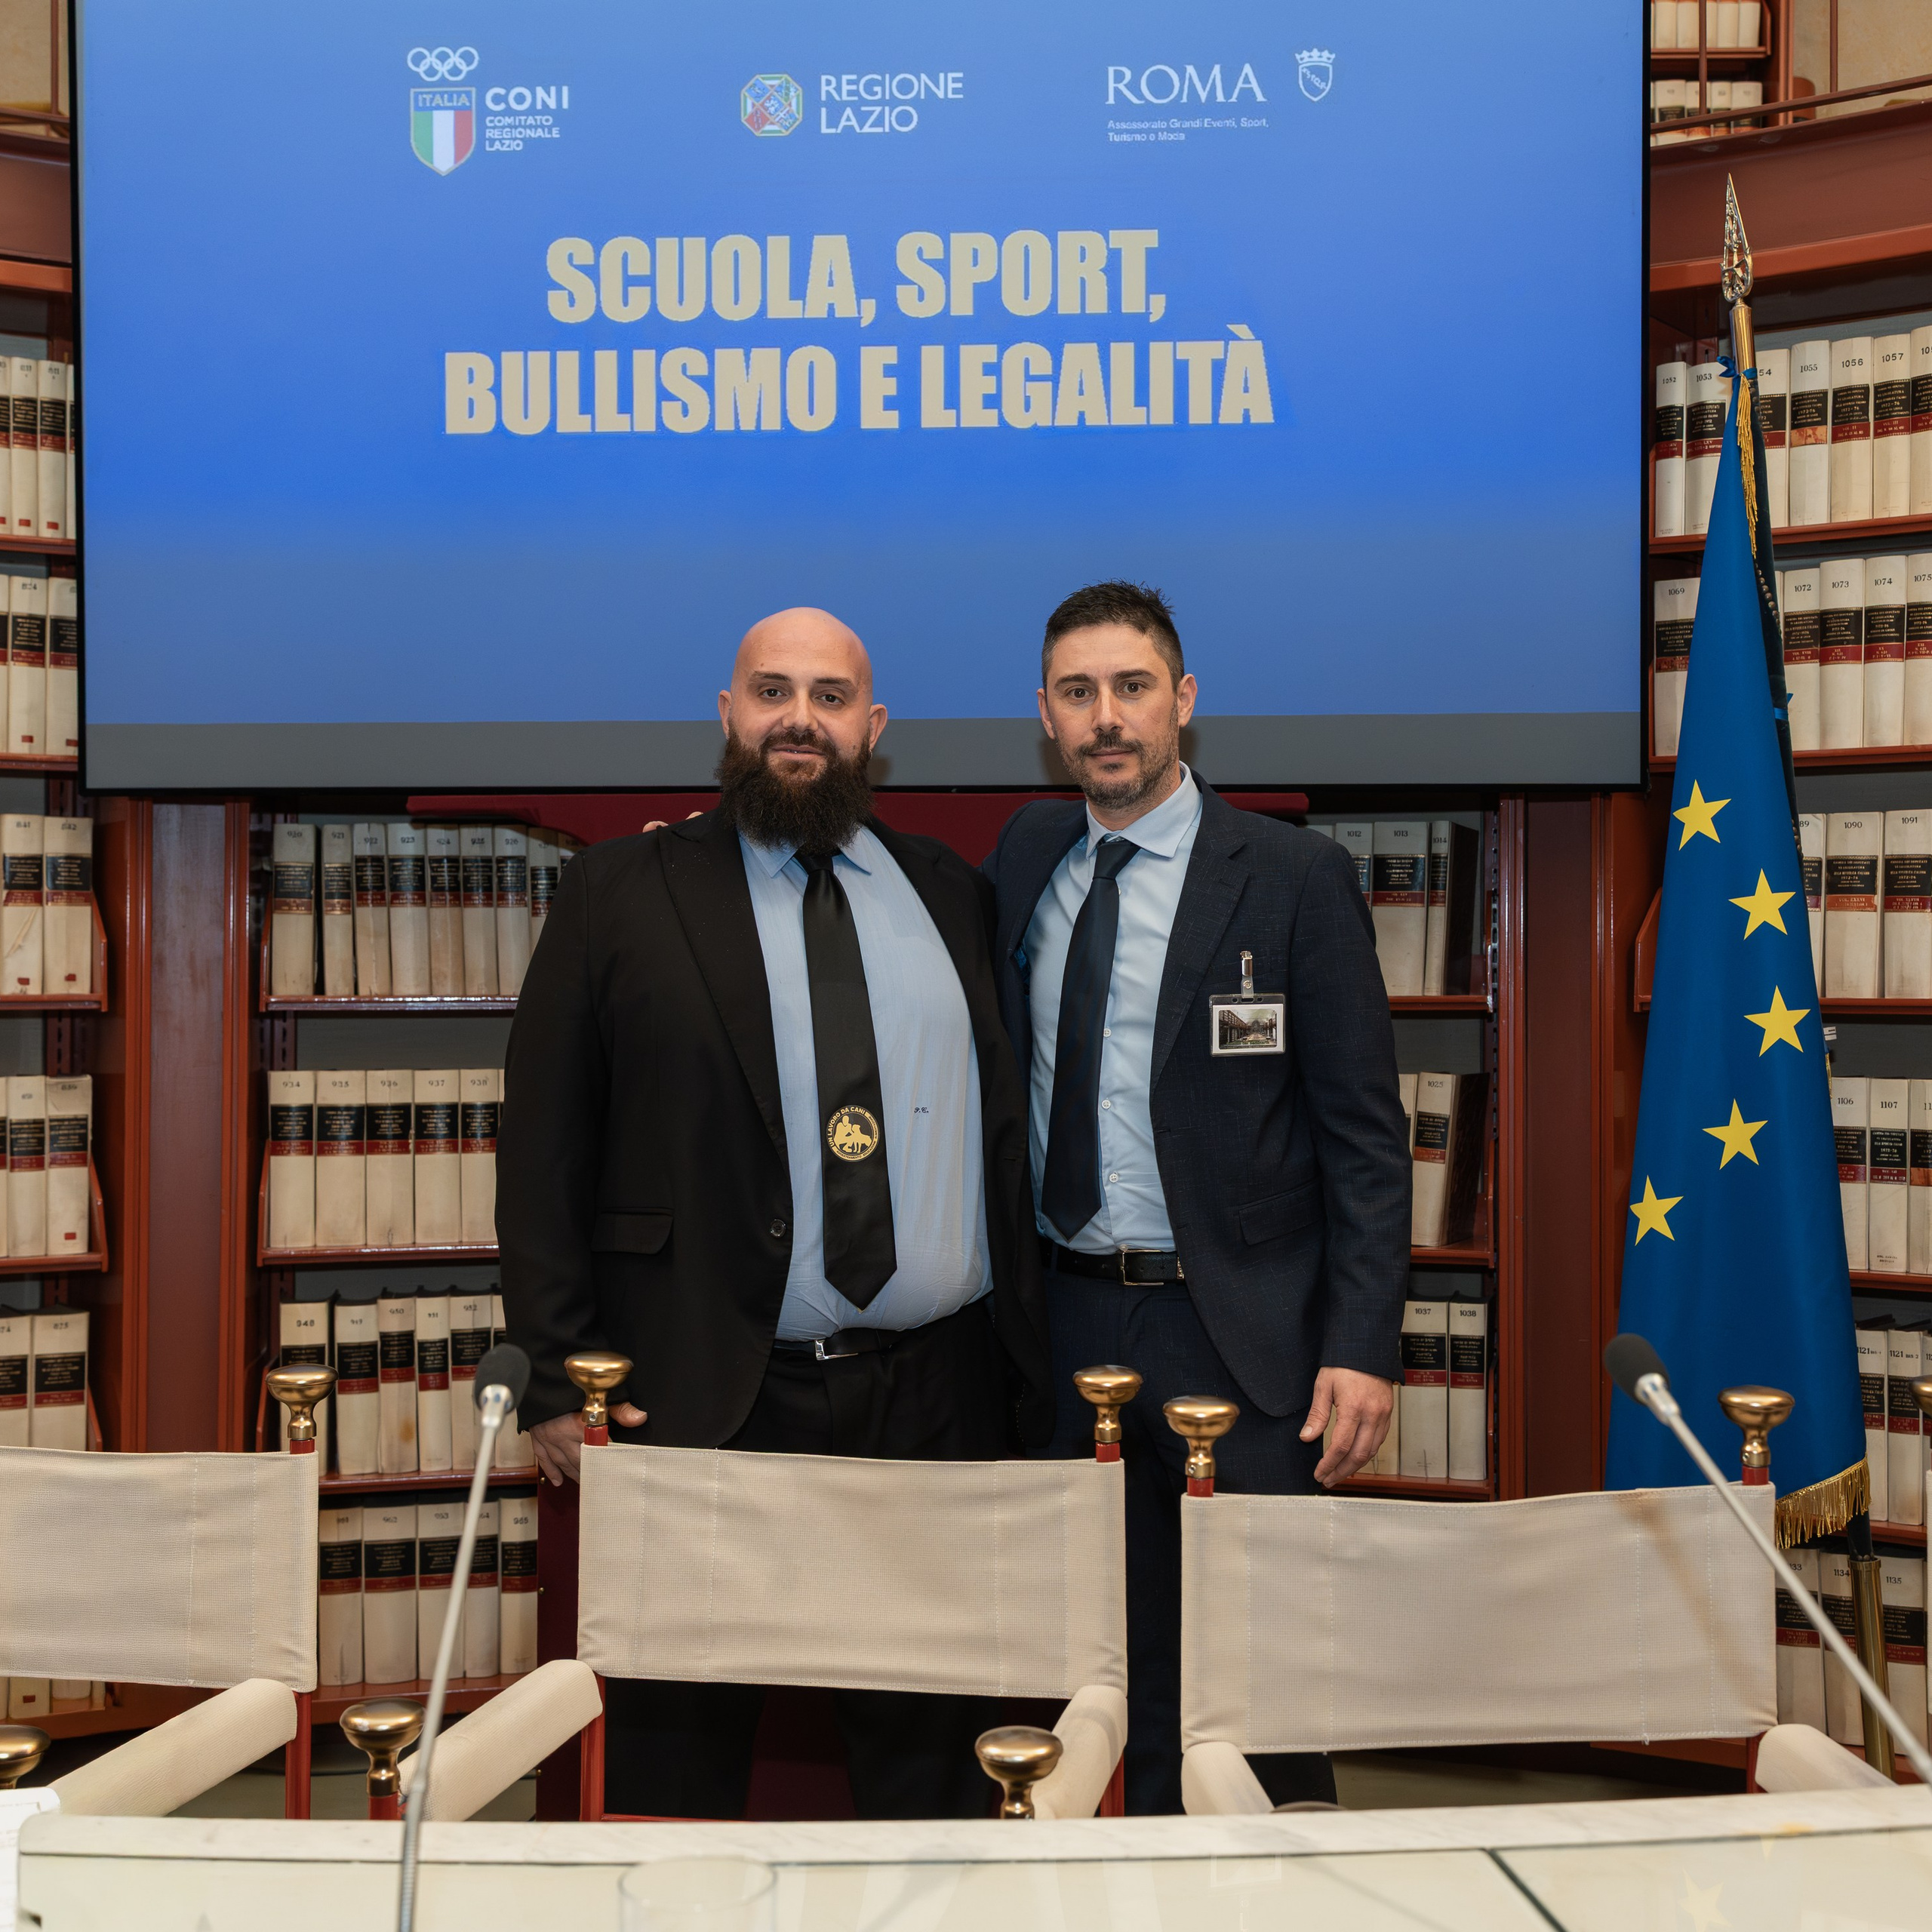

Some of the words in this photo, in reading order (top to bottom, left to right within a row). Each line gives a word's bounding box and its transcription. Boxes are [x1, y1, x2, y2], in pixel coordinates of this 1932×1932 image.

[820, 72, 964, 101] REGIONE
[1106, 63, 1267, 104] ROMA
[418, 94, 469, 107] ITALIA
[485, 86, 568, 111] CONI
[485, 115, 552, 127] COMITATO
[820, 106, 918, 134] LAZIO
[1169, 118, 1202, 128] Grandi
[1204, 118, 1237, 128] Eventi,
[1241, 117, 1269, 128] Sport,
[485, 128, 560, 139] REGIONALE
[1108, 133, 1147, 141] Turismo
[1158, 131, 1185, 141] Moda
[485, 140, 523, 151] LAZIO
[546, 235, 876, 327] SCUOLA,
[897, 229, 1165, 322] SPORT,
[1921, 346, 1932, 355] 10
[1881, 352, 1903, 363] 1057
[1841, 358, 1863, 368] 1056
[1800, 364, 1818, 373] 1055
[445, 346, 836, 435] BULLISMO
[860, 346, 899, 429] E
[921, 325, 1274, 429] LEGALITÀ
[1696, 373, 1712, 383] 1053
[1875, 577, 1893, 586] 1074
[1914, 574, 1932, 582] 1075
[1795, 584, 1811, 592] 1072
[1832, 580, 1849, 589] 1073
[1668, 587, 1684, 595] 1069
[850, 1106, 866, 1115] CANI
[828, 1112, 841, 1136] LAVORO
[828, 1137, 835, 1147] UN
[1886, 1576, 1902, 1584] 1135
